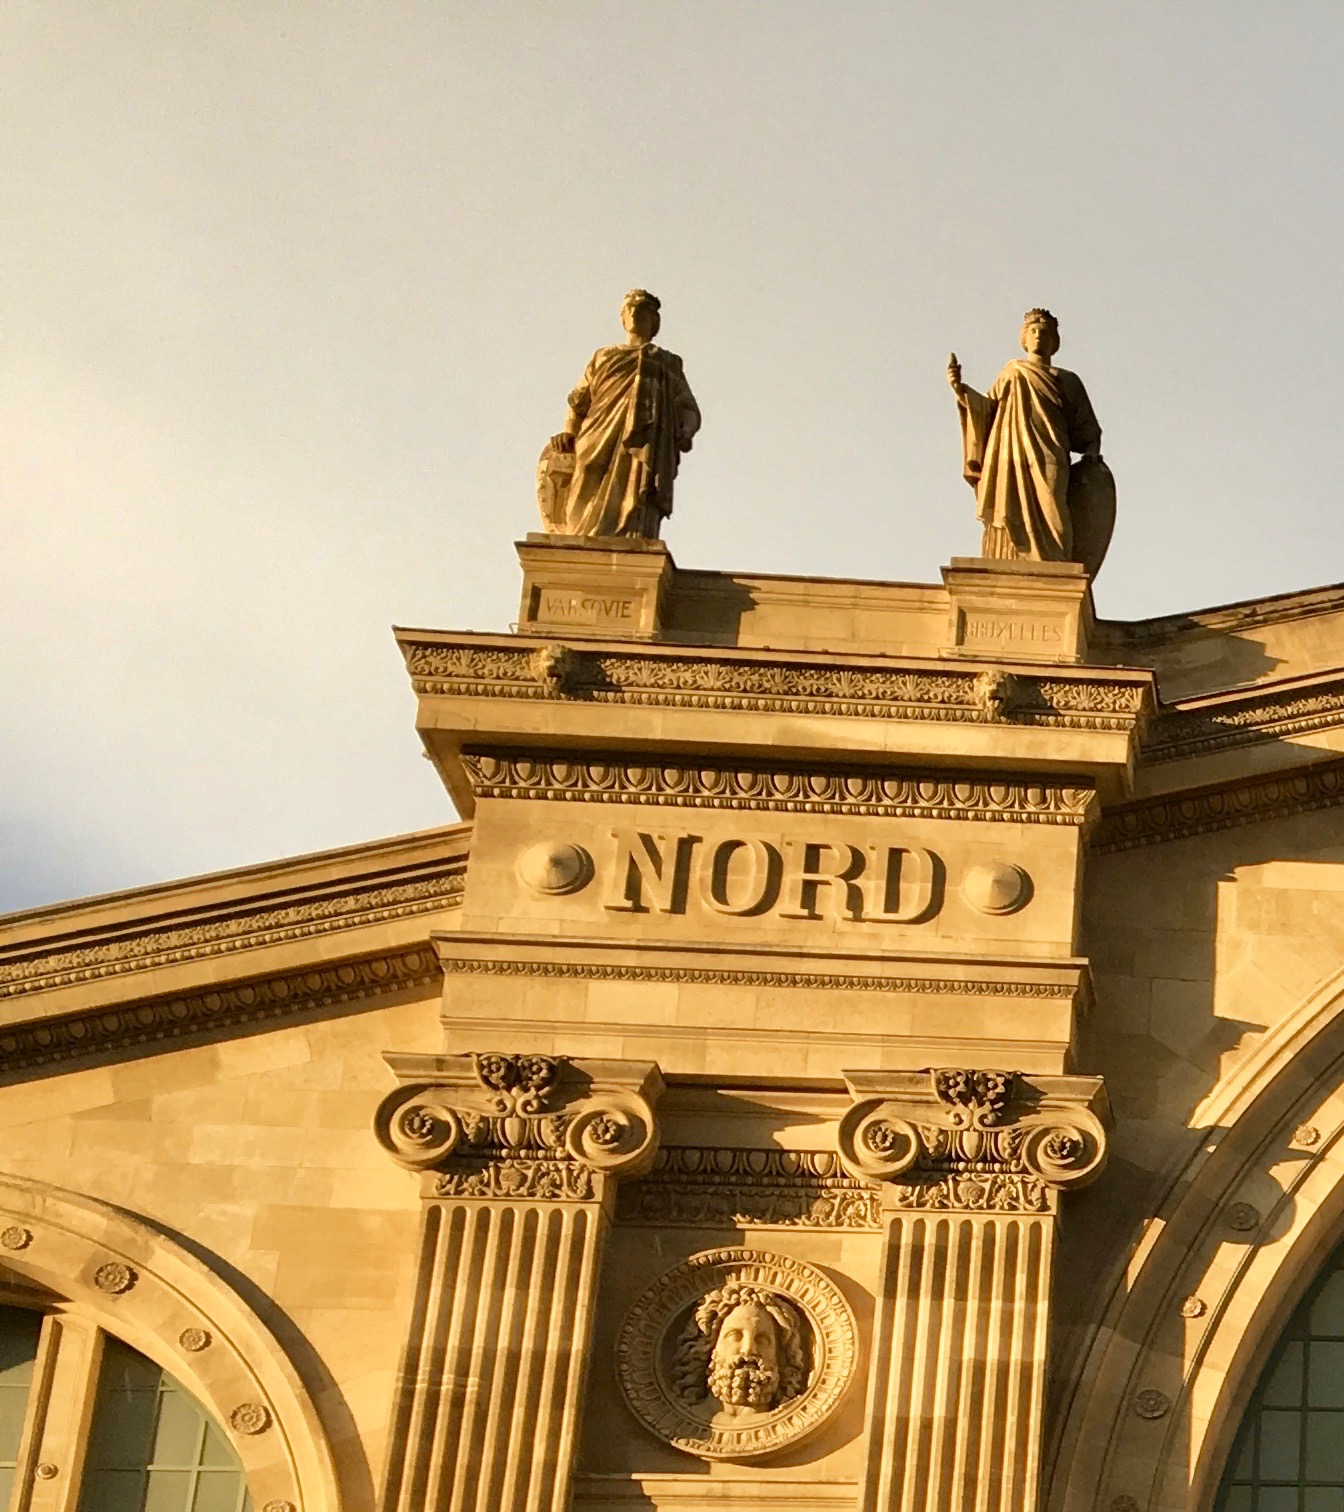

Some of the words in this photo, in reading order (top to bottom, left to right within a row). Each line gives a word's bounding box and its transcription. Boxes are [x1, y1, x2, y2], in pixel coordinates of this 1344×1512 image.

[546, 597, 632, 618] VARSOVIE
[966, 620, 1061, 641] BRUXELLES
[604, 827, 947, 925] NORD
